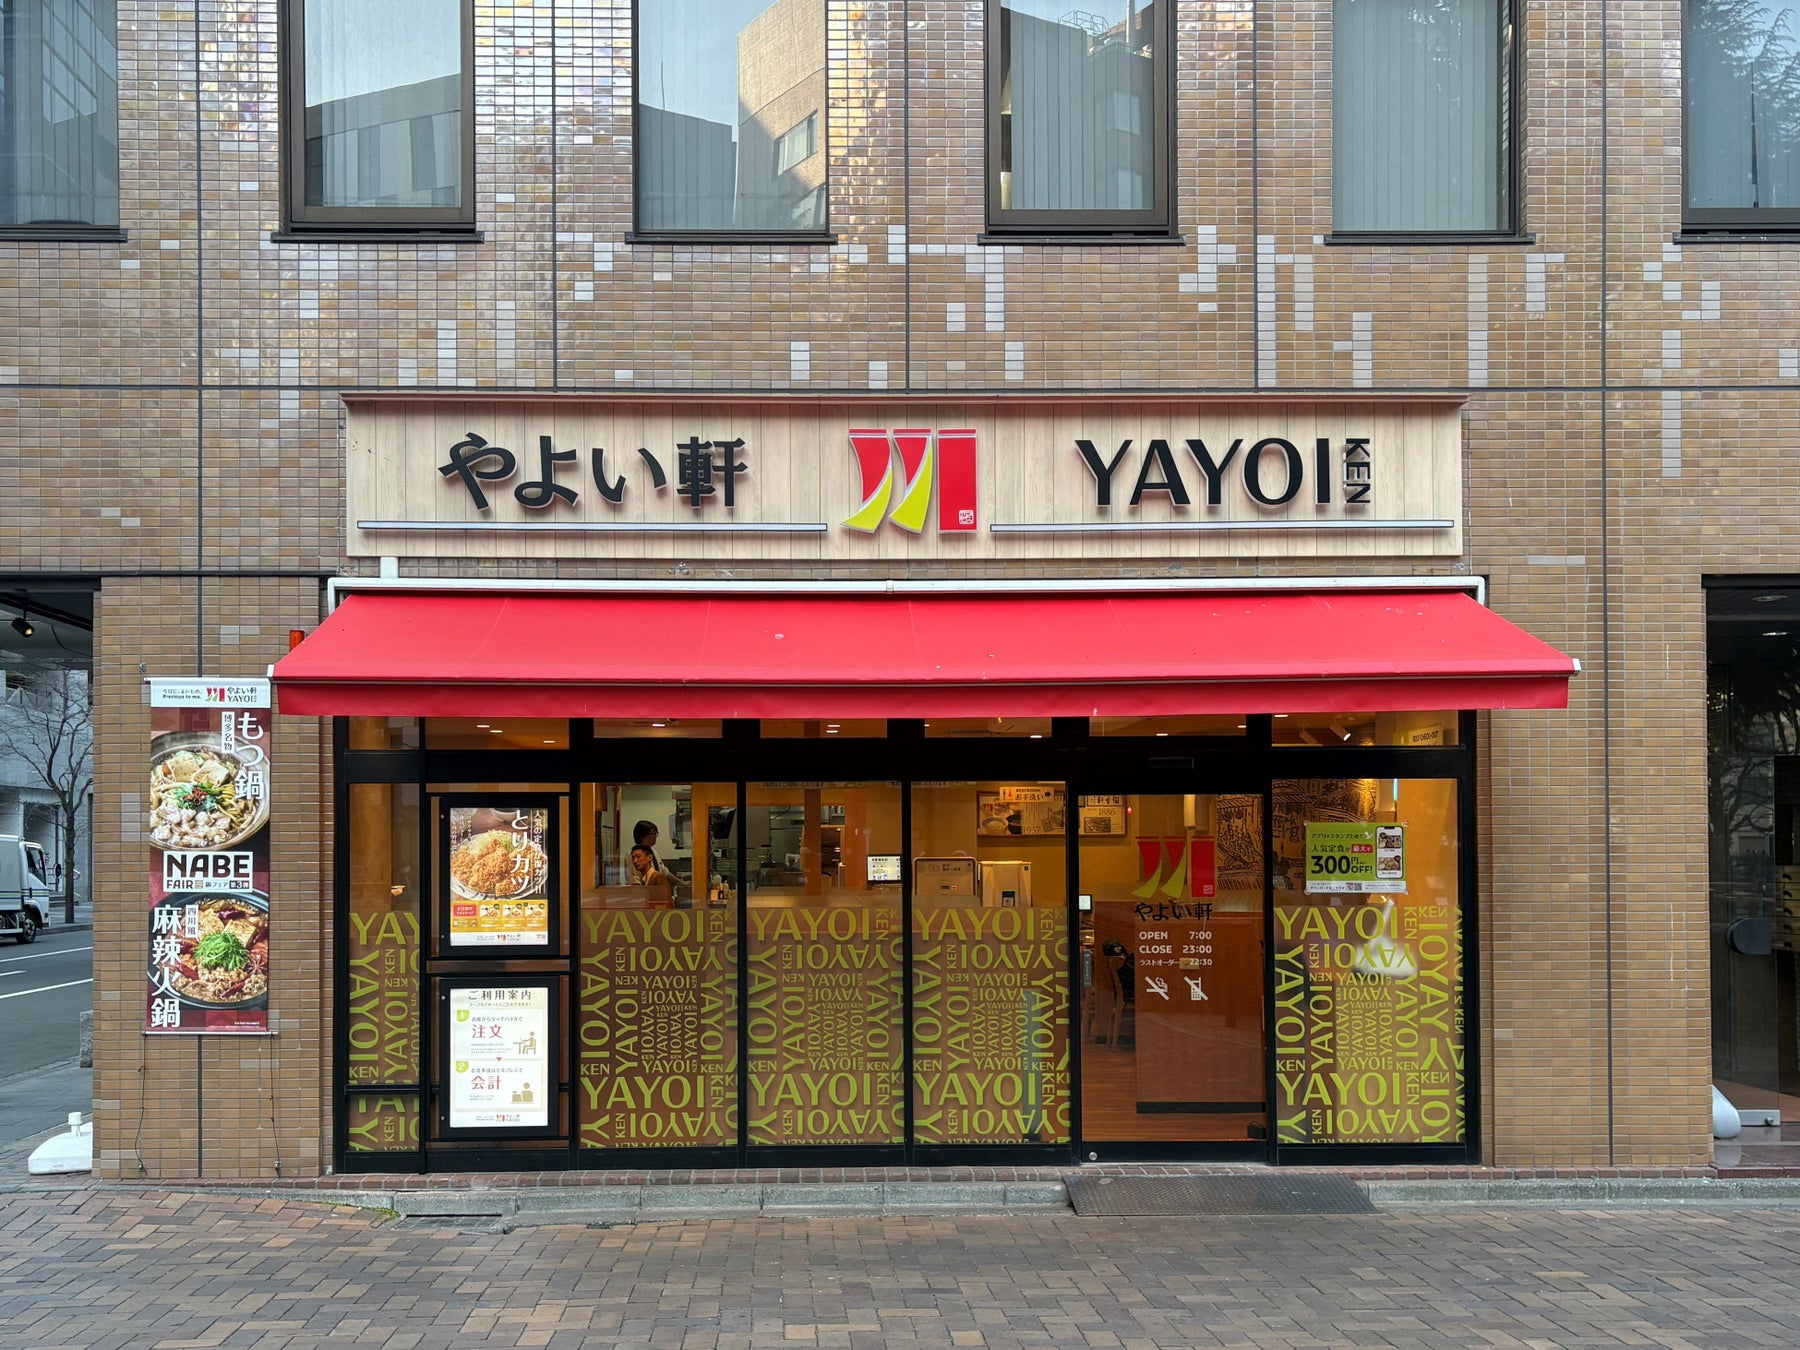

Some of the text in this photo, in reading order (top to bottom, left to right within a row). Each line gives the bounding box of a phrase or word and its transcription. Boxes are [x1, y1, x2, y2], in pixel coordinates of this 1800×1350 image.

[439, 433, 747, 512] やよい軒
[1075, 438, 1371, 506] YAYOI KEN
[227, 687, 257, 695] やよい軒
[227, 695, 253, 703] YAYOI
[224, 714, 233, 751] 博多名物
[236, 712, 264, 800] もつ鍋
[1015, 793, 1044, 801] お手洗い
[166, 854, 250, 878] NABE
[510, 809, 530, 894] とりカツ
[1311, 855, 1351, 874] 300
[166, 880, 193, 889] FAIR
[1351, 865, 1373, 874] OFF!
[187, 907, 197, 935] 四川風
[582, 910, 704, 944] YAYOI
[710, 910, 723, 942] KEN
[750, 908, 889, 941] YAYOI KEN
[914, 908, 1054, 941] YAYOI KEN
[1133, 902, 1213, 922] やよい軒
[1275, 907, 1417, 941] YAYOI KEN
[349, 912, 420, 946] YAY
[1139, 931, 1212, 940] OPEN 7:00
[385, 948, 395, 974] KEN
[616, 946, 723, 972] YAYOI KEN
[783, 944, 889, 969] YAYOI KEN
[948, 945, 957, 969] KEN
[962, 944, 1054, 969] YAYOI
[1139, 945, 1212, 954] CLOSE 23:00
[1309, 943, 1417, 969] YAYOI KEN
[152, 904, 183, 1028] 麻辣火鍋
[468, 990, 531, 1000] ご利用案内
[748, 946, 777, 1072] YAYOI KEN
[913, 946, 942, 1072] YAYOI KEN
[1274, 945, 1305, 1071] YAYOI KEN
[349, 949, 379, 1079] YAYOI KEN
[580, 948, 610, 1075] YAYOI KEN
[616, 976, 638, 1074] YAYOI KEN
[701, 976, 723, 1059] YAYOI
[783, 974, 806, 1071] YAYOI KEN
[867, 974, 889, 1070] YAYOI KEN
[948, 974, 971, 1071] YAYOI KEN
[1032, 974, 1054, 1070] YAYOI KEN
[1310, 973, 1334, 1071] YAYOI KEN
[1395, 973, 1419, 1056] YAYOI
[384, 991, 408, 1078] YAYOI
[472, 1024, 503, 1039] 注文
[471, 1075, 502, 1090] 会計
[580, 1075, 723, 1109] YAYOI KEN
[748, 1072, 889, 1106] YAYOI KEN
[913, 1072, 1054, 1106] YAYOI KEN
[1275, 1072, 1419, 1106] YAYOI KEN
[384, 1116, 395, 1142] KEN
[616, 1113, 625, 1138] KEN
[630, 1112, 723, 1138] YAYOI
[783, 1110, 793, 1135] KEN
[798, 1109, 889, 1135] YAYOI
[948, 1110, 958, 1134] KEN
[963, 1109, 1055, 1135] YAYOI
[1311, 1110, 1321, 1134] KEN
[1326, 1109, 1420, 1135] YAYOI
